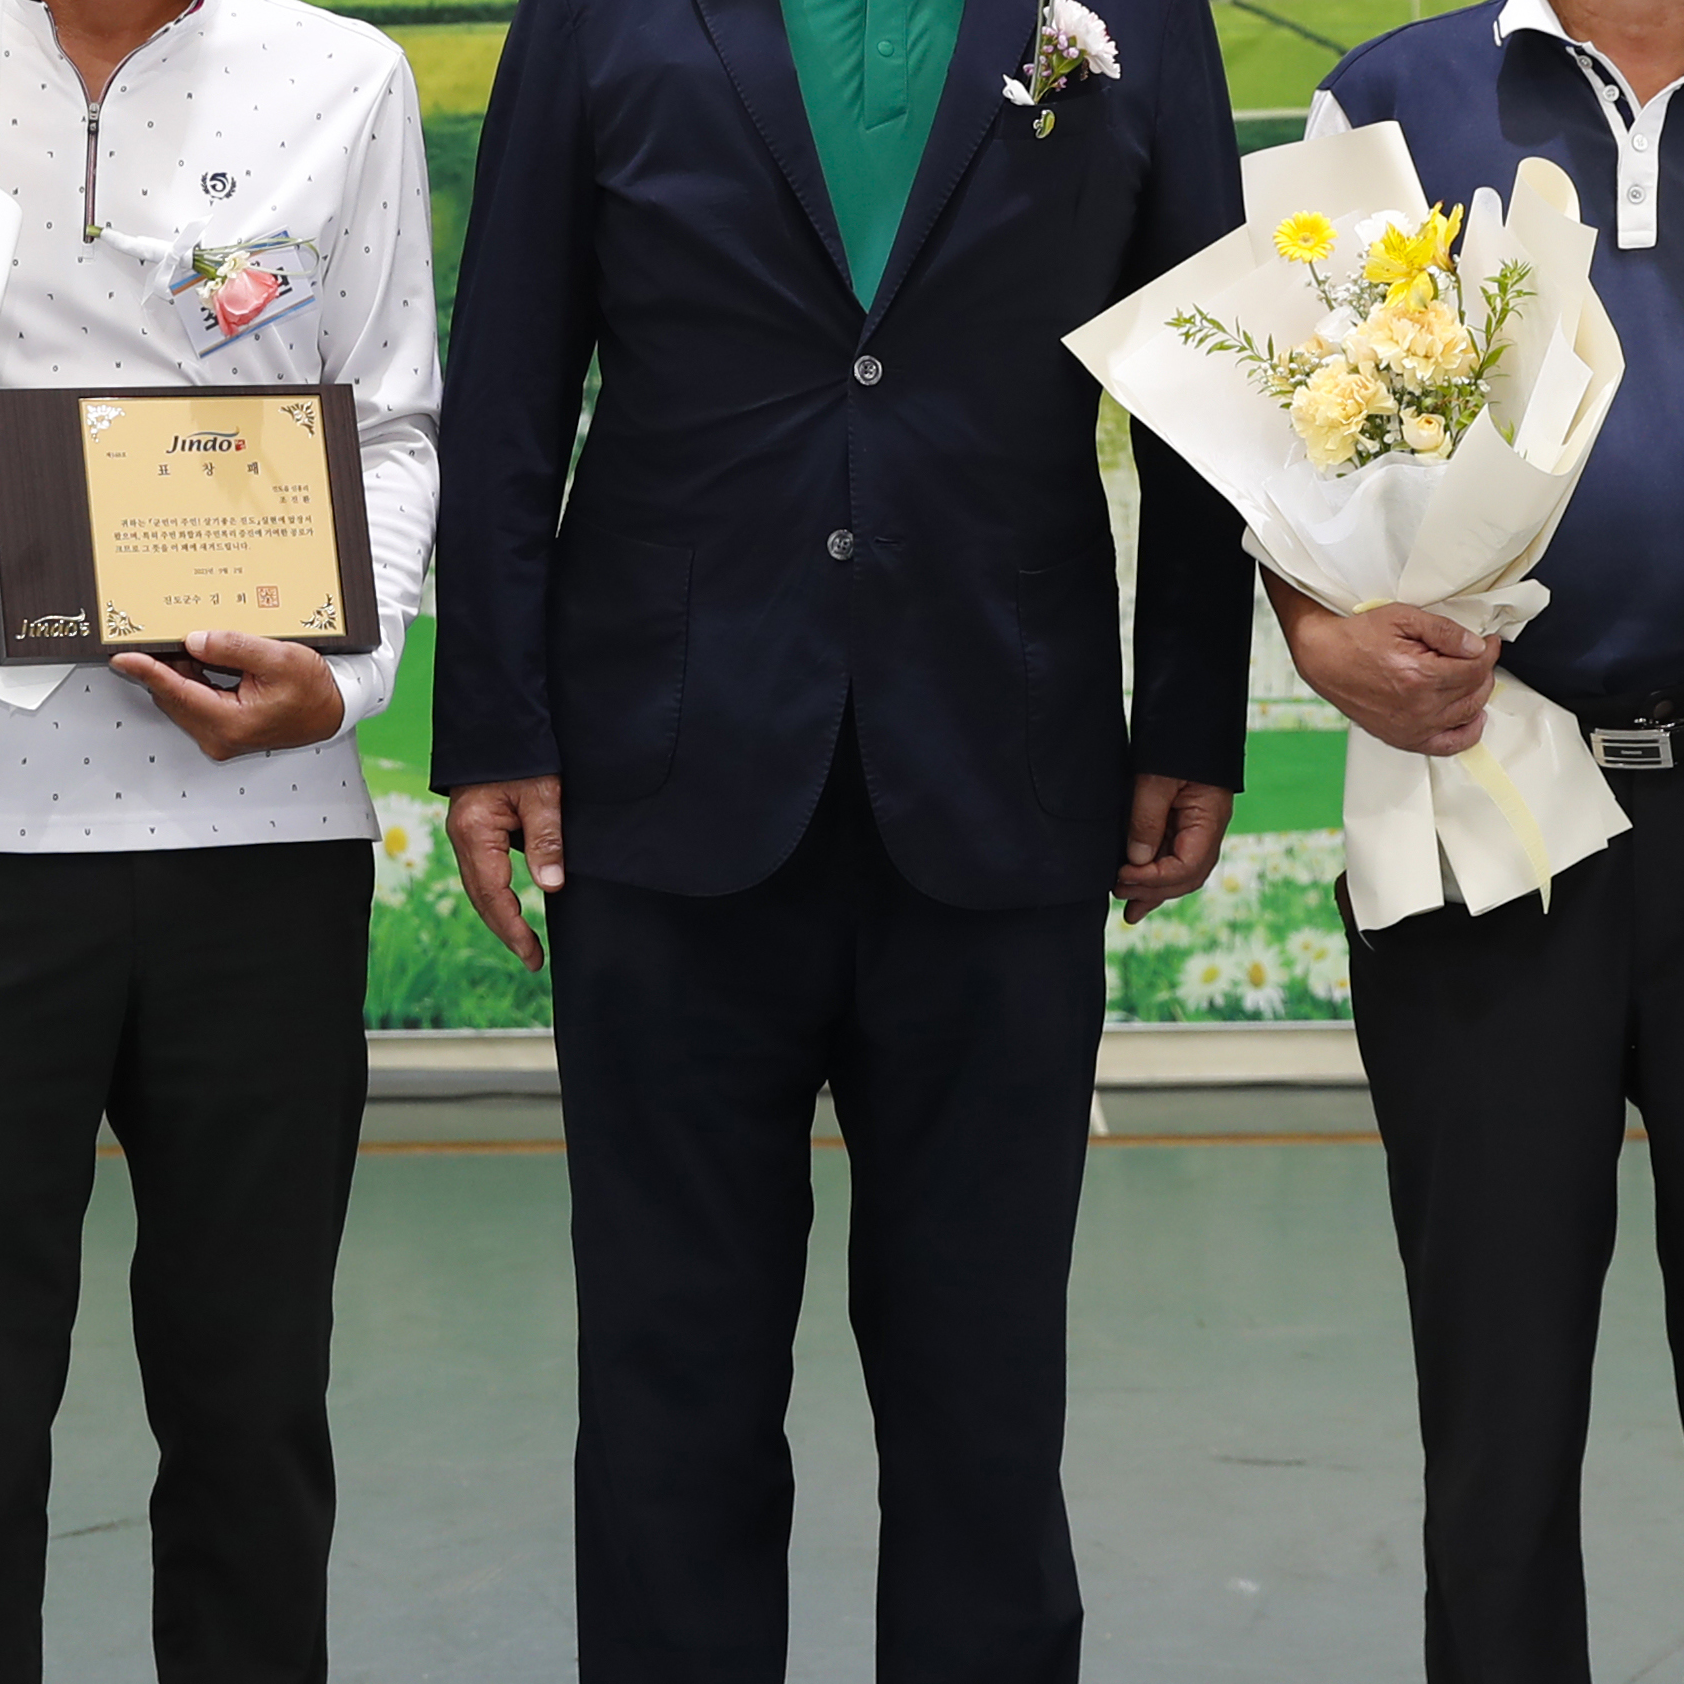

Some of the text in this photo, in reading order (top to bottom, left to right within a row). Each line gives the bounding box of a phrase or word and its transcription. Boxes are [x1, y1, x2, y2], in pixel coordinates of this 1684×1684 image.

[166, 436, 232, 454] Jindo
[158, 462, 259, 476] 표 창 패
